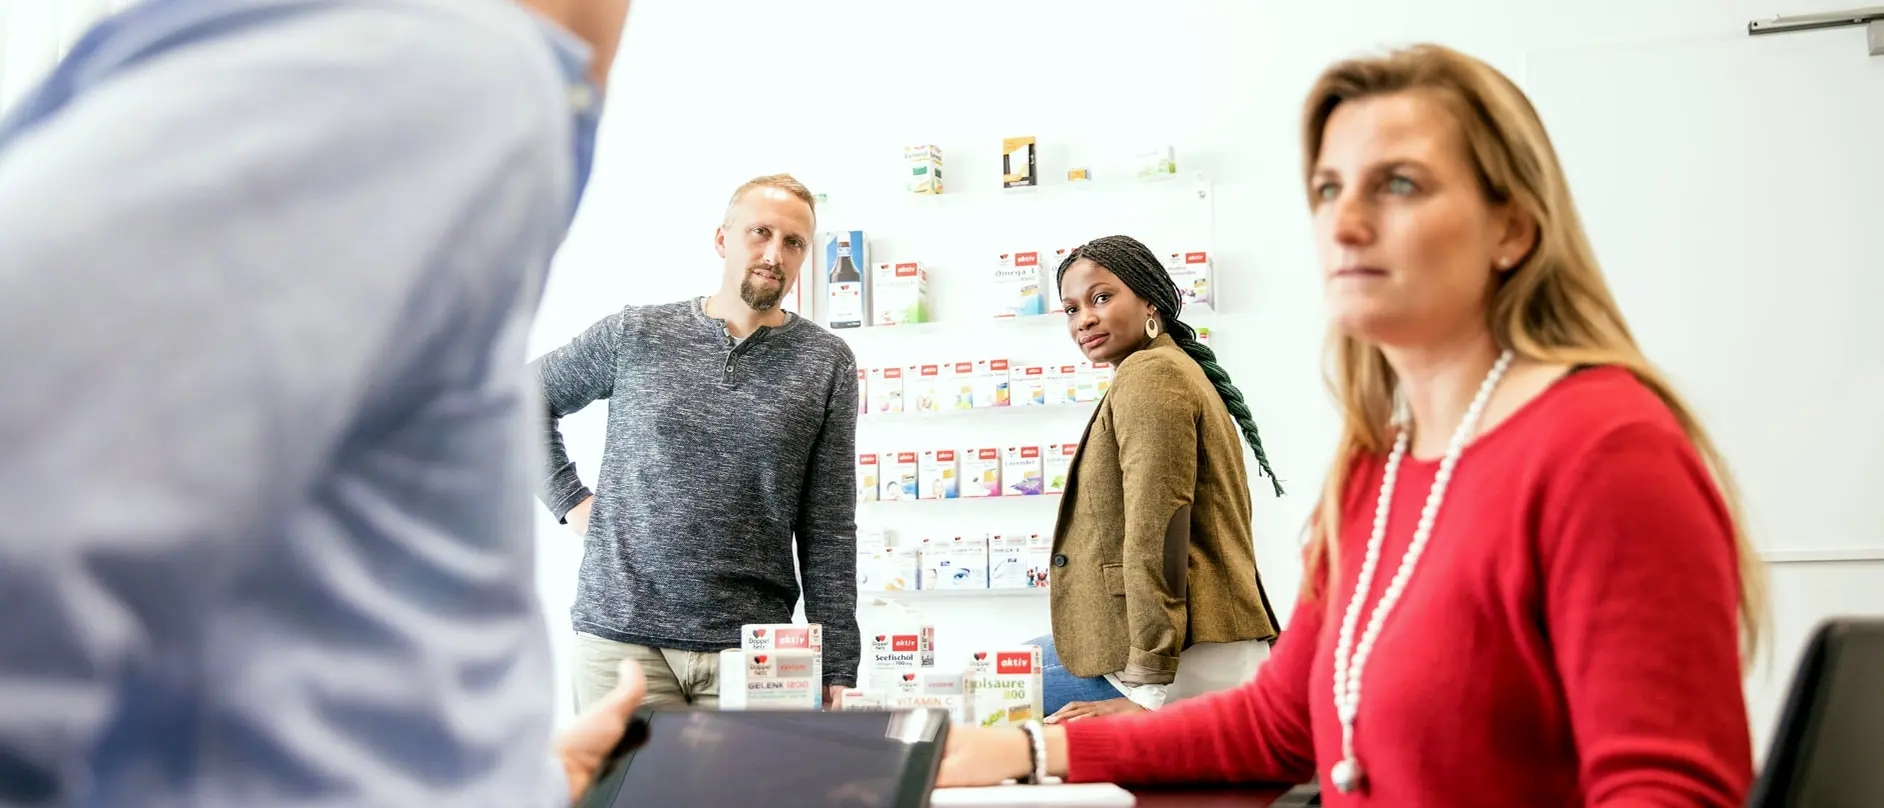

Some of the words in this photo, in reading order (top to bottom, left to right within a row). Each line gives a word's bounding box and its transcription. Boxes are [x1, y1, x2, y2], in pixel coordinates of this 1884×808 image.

[779, 636, 806, 645] aktiv
[1000, 657, 1028, 668] aktiv
[748, 681, 784, 690] GELENK
